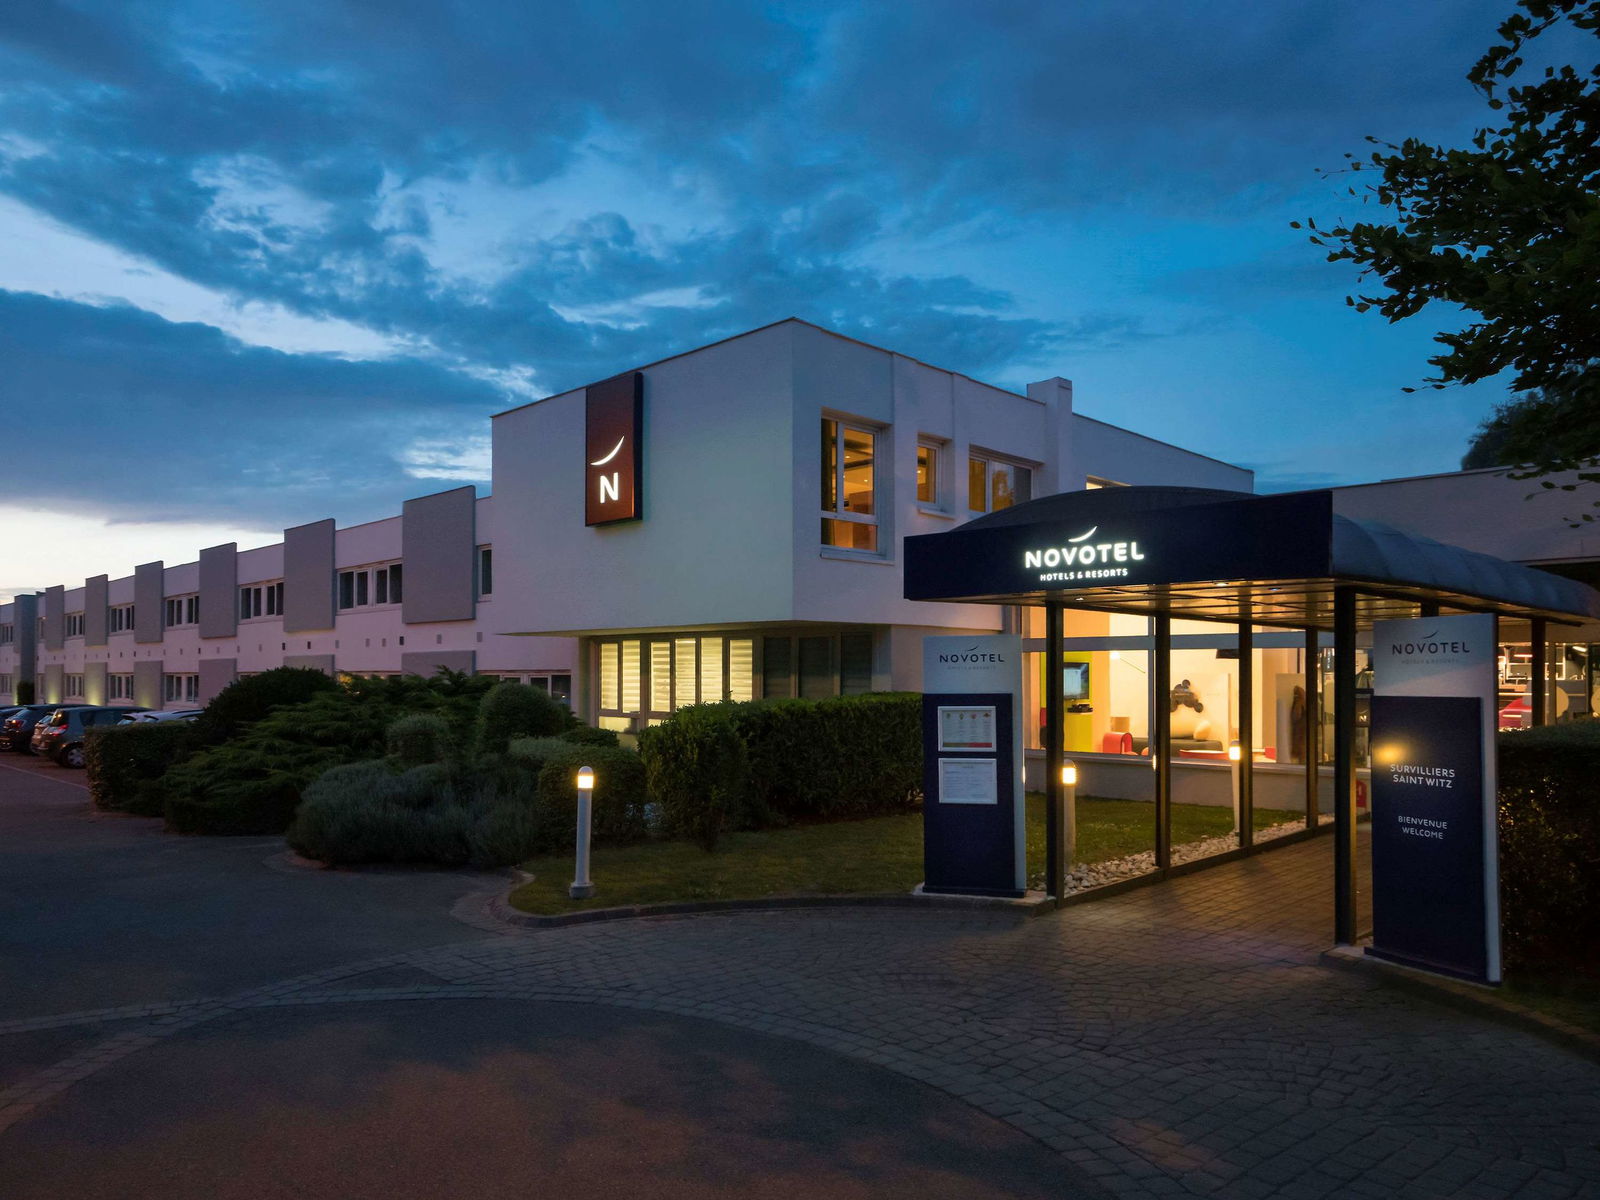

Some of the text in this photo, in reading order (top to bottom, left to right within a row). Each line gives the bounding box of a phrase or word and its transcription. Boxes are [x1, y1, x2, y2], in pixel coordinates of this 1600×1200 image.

[600, 473, 618, 503] N
[1025, 542, 1144, 568] NOVOTEL
[1040, 568, 1128, 582] HOTELS & RESORTS
[1392, 642, 1471, 655] NOVOTEL
[939, 653, 1005, 663] NOVOTEL
[1390, 763, 1456, 778] SURVILLIERS
[1392, 774, 1453, 789] SAINT WITZ
[1397, 815, 1448, 830] BIENVENUE
[1401, 827, 1444, 840] WELCOME
